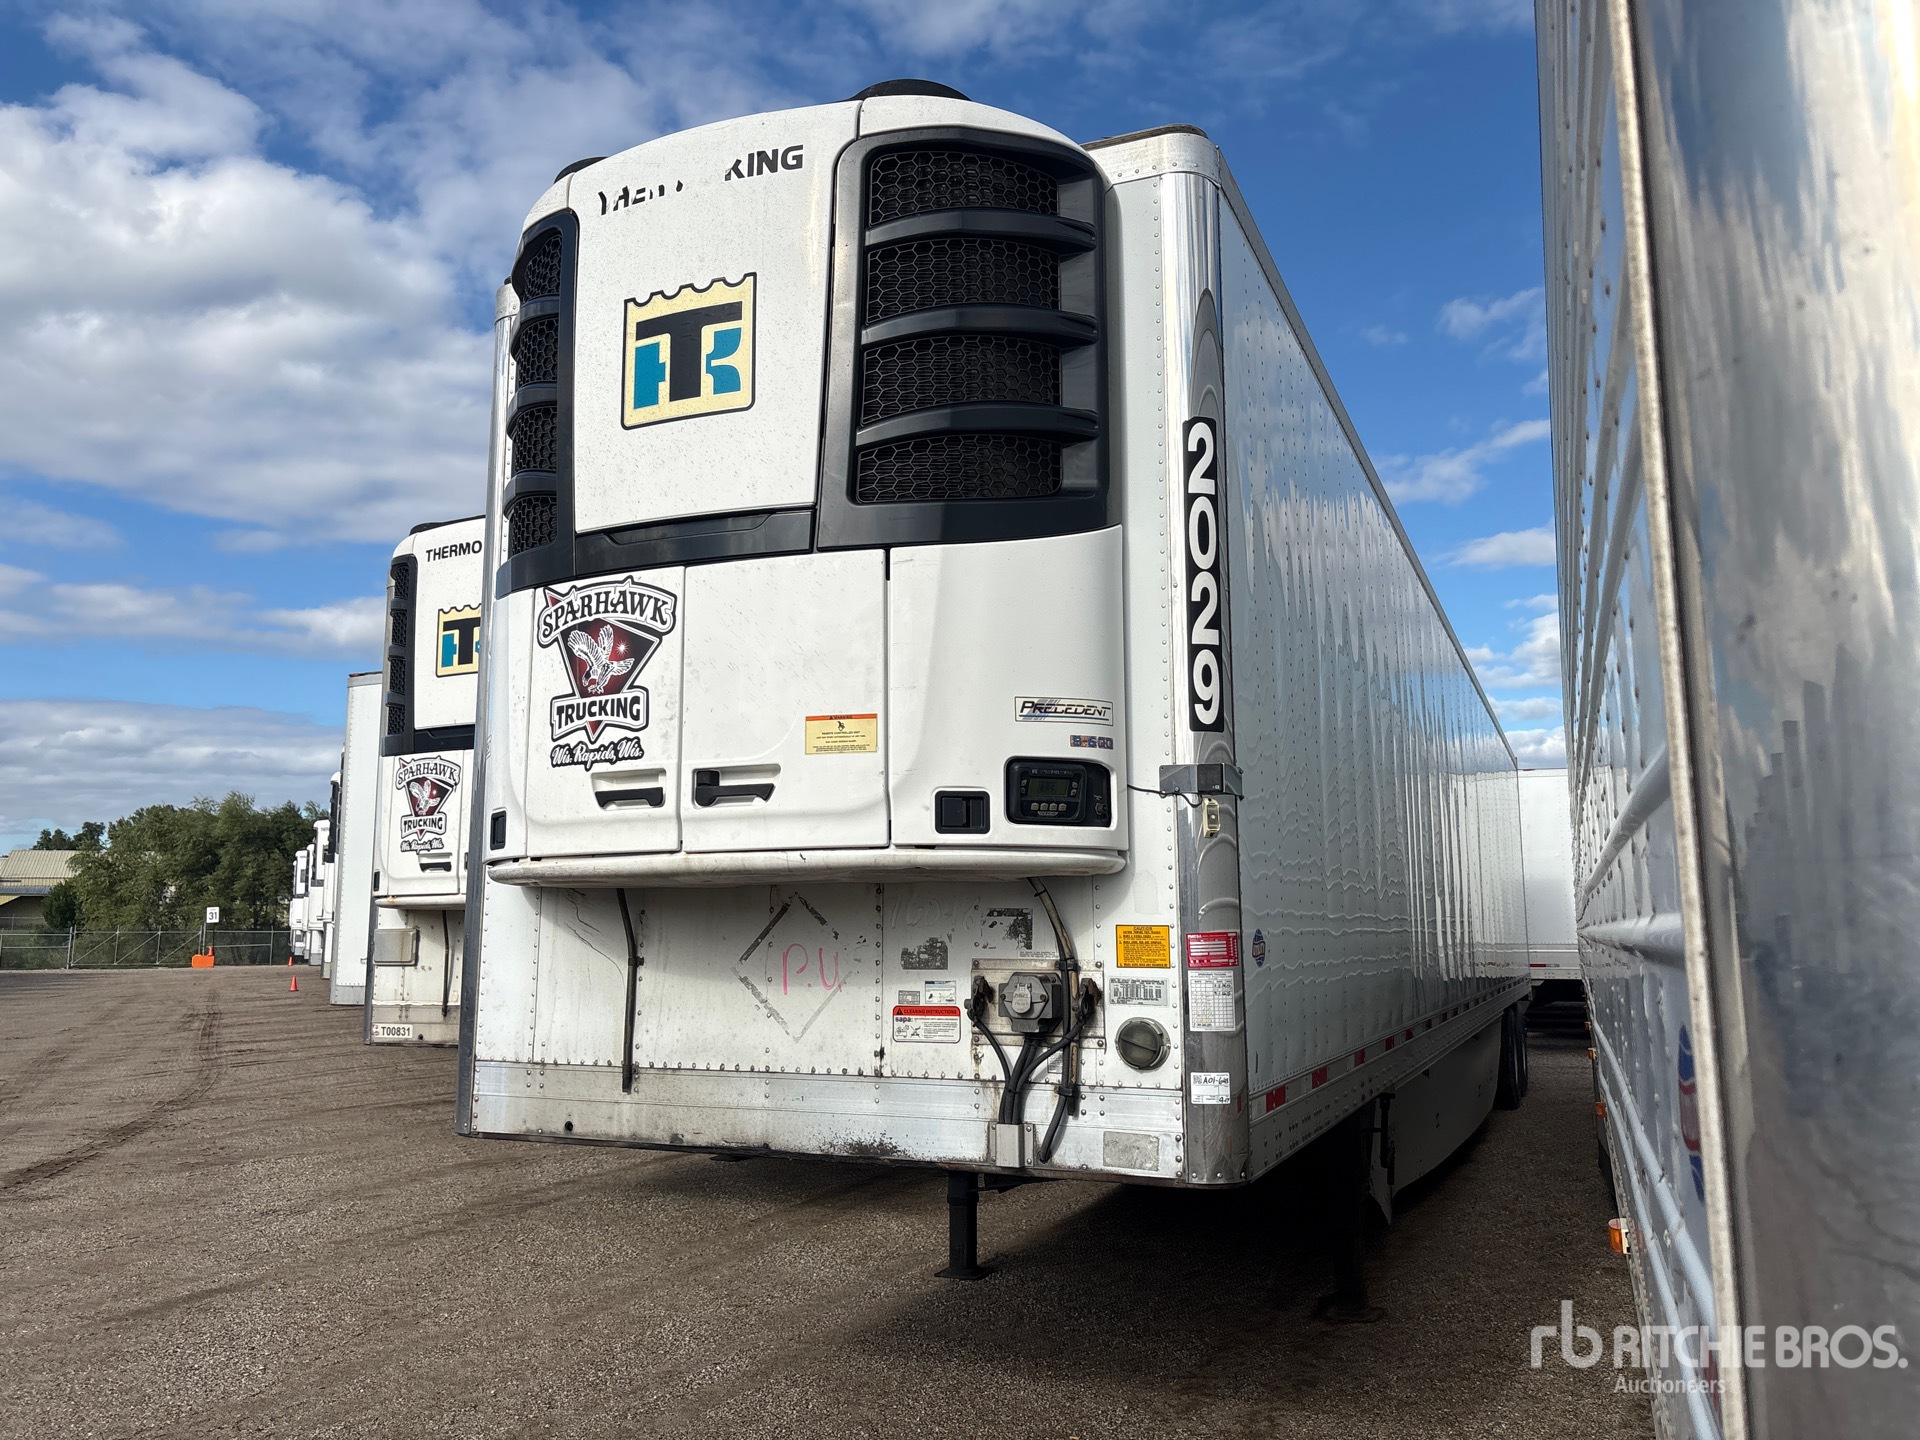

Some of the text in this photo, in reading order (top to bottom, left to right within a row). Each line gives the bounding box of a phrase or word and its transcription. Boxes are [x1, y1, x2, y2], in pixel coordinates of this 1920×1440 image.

[725, 144, 804, 181] KING
[425, 540, 483, 562] THERMO
[1187, 421, 1220, 726] 2029
[542, 589, 669, 638] SPARHAWK
[556, 695, 641, 730] TRUCKING
[397, 762, 457, 785] SPARHAWK
[403, 816, 443, 833] TRUCKING
[208, 911, 218, 920] 31
[381, 1026, 411, 1036] T00831
